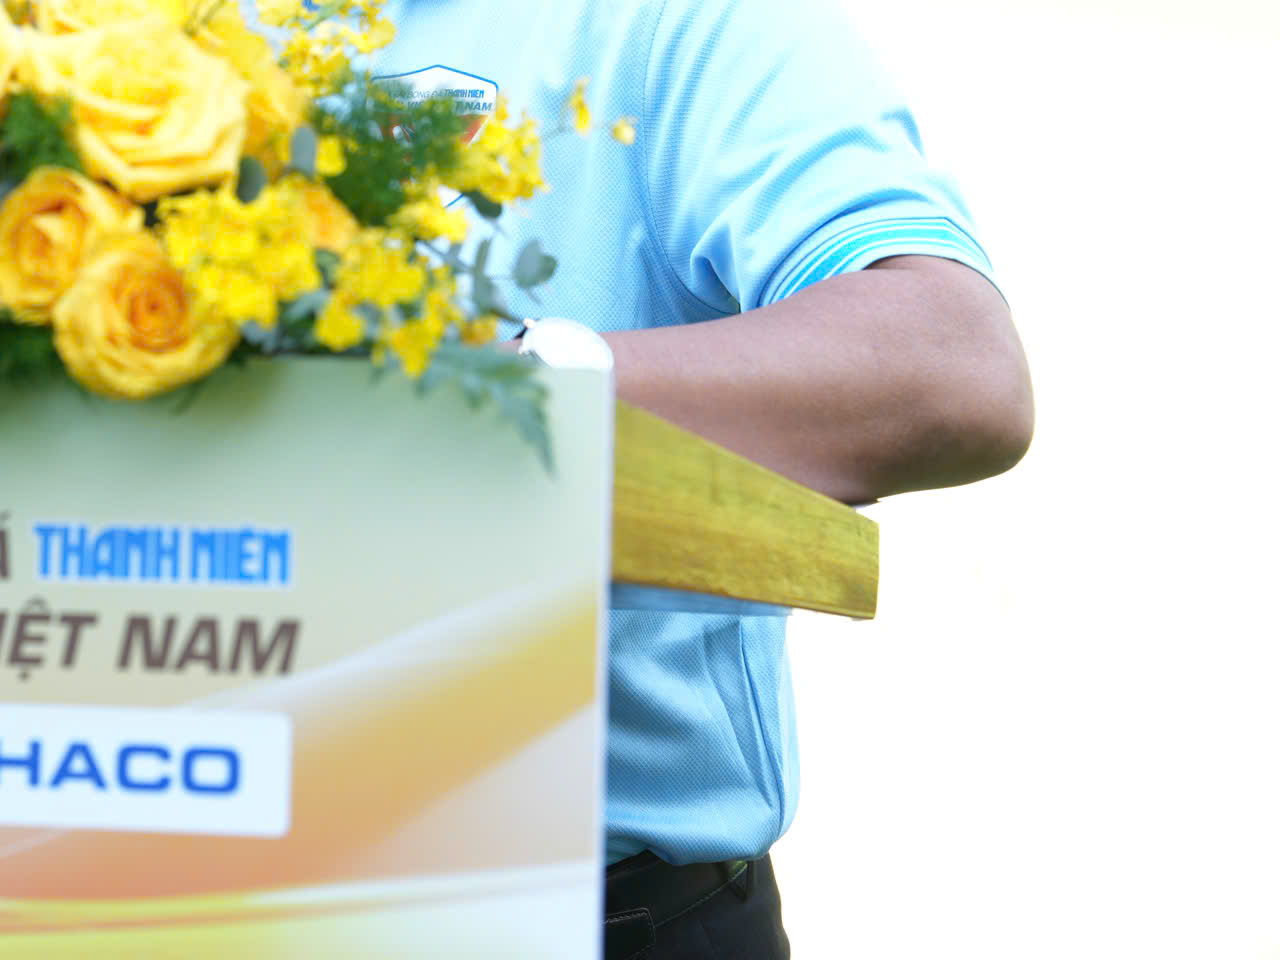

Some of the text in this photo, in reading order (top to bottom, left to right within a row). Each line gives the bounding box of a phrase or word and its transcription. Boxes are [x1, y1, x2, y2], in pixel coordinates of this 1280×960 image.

[464, 101, 493, 111] NAM
[33, 523, 180, 583] THANH
[116, 613, 302, 676] NAM
